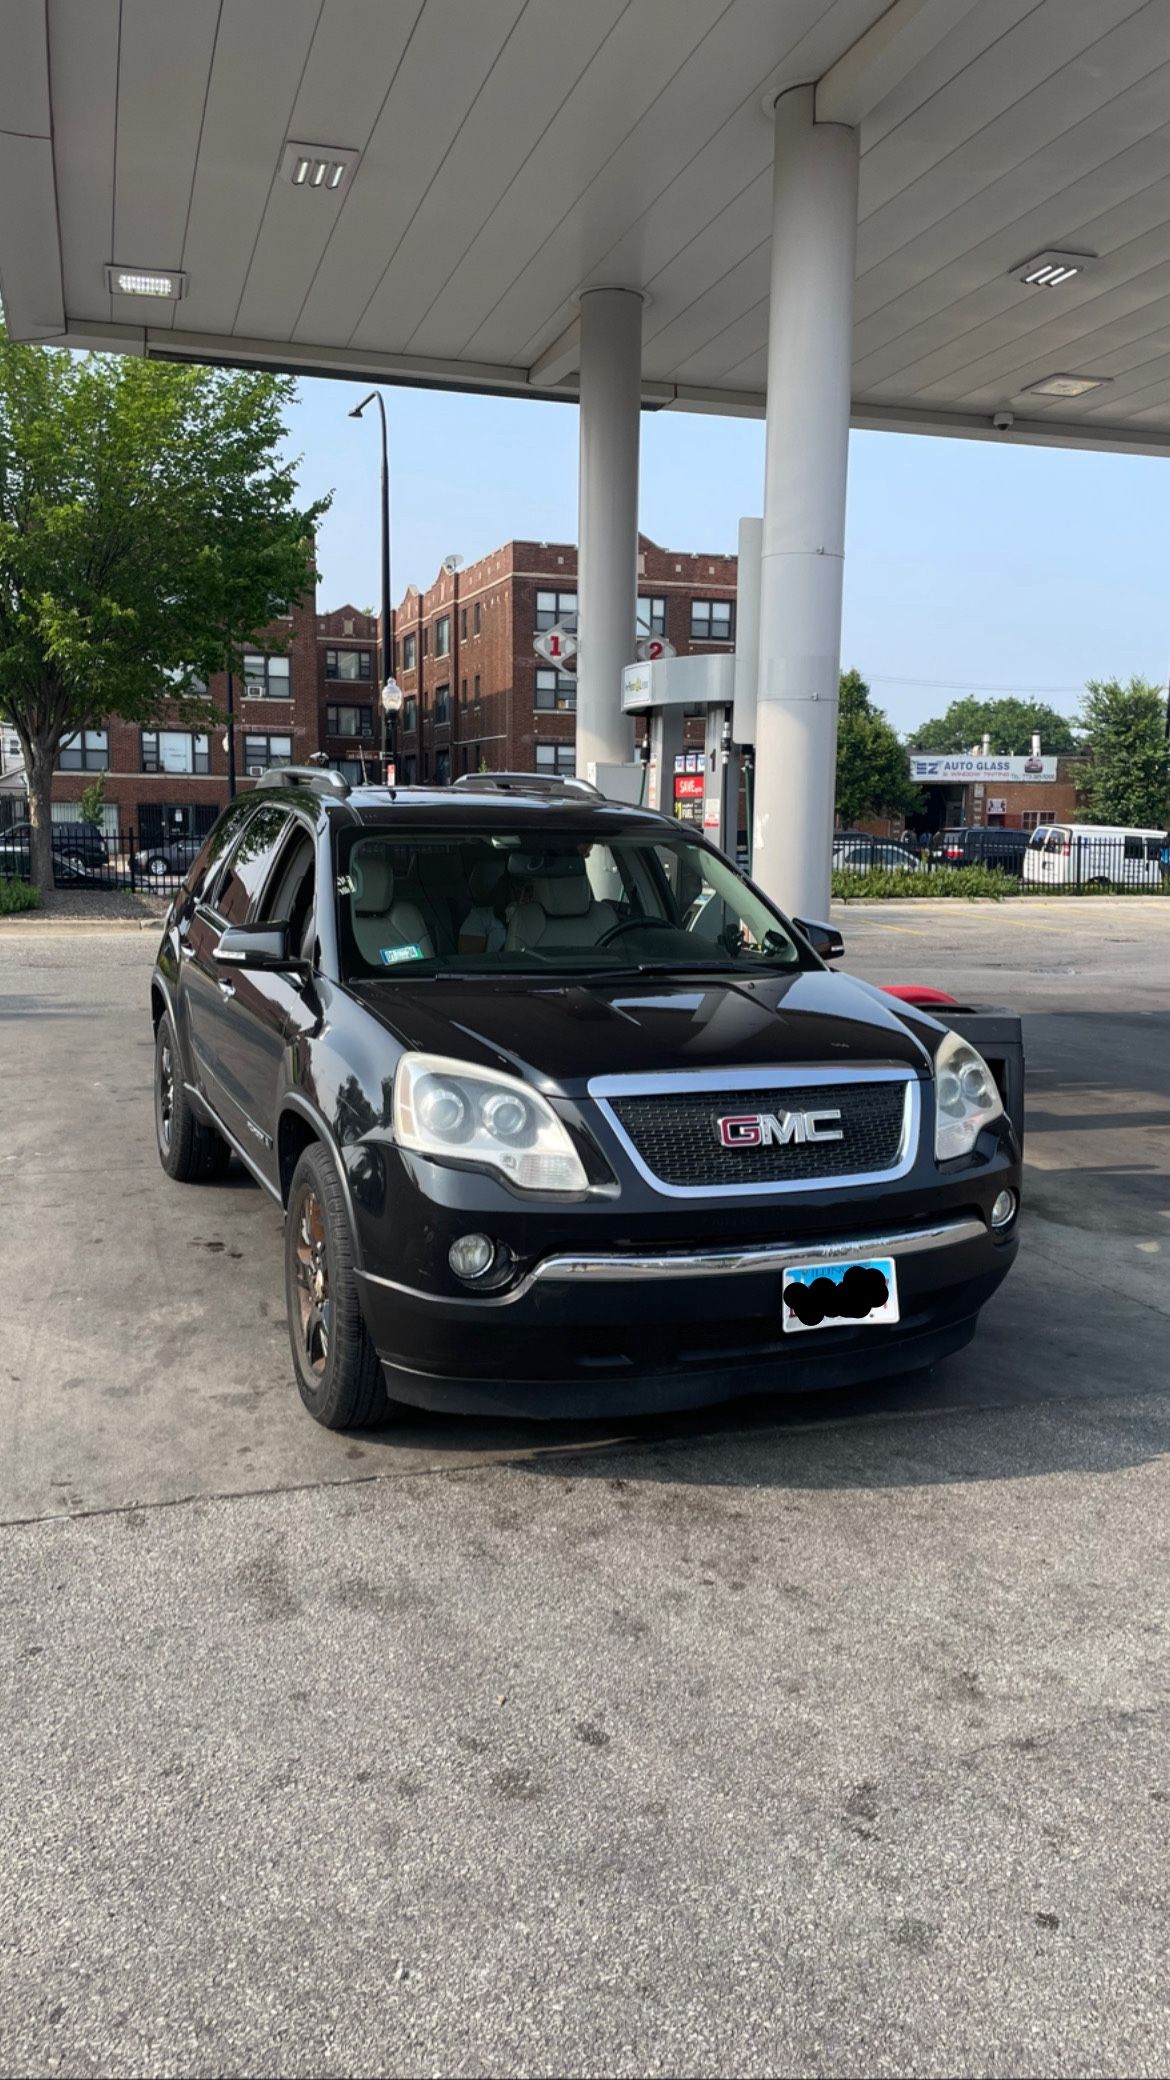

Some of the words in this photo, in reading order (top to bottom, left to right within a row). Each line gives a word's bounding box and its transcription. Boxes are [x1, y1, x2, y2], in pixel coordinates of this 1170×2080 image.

[550, 635, 561, 656] 1
[649, 641, 663, 660] 2
[916, 762, 938, 775] EZ
[944, 761, 973, 771] AUTO
[976, 762, 1010, 771] GLASS
[718, 1108, 844, 1148] GMC
